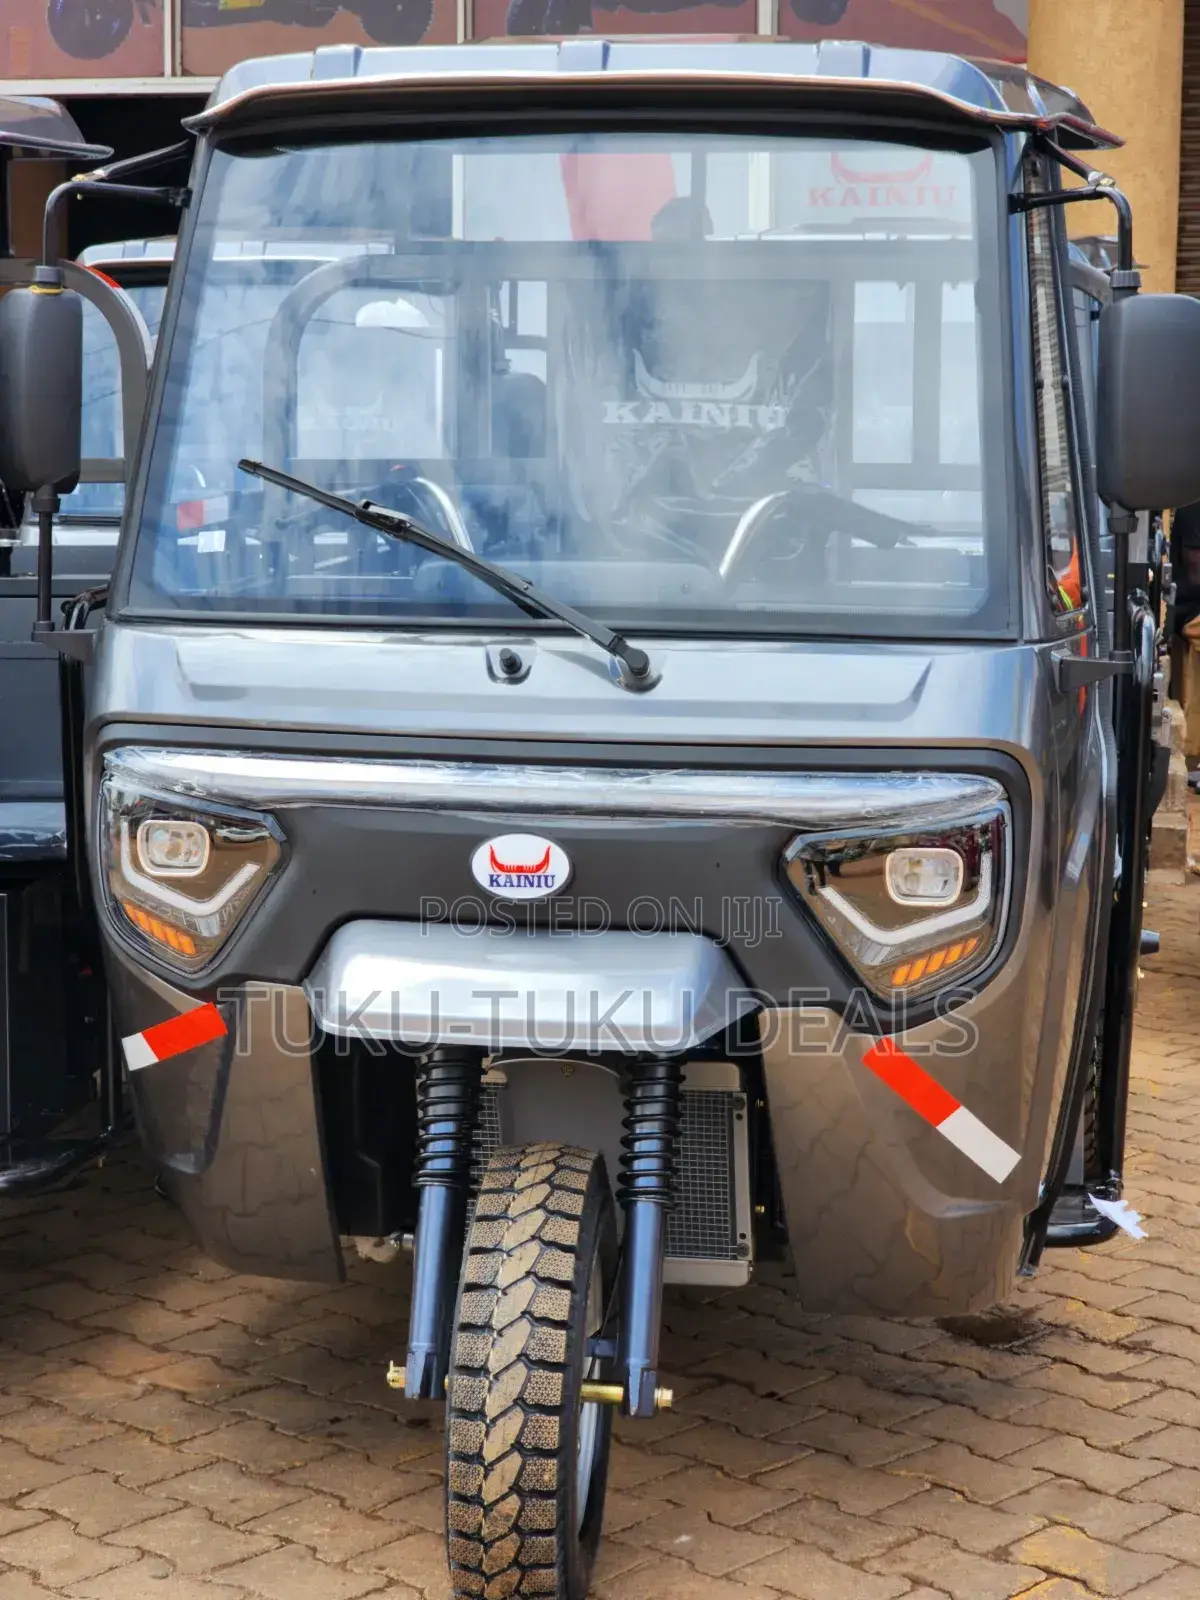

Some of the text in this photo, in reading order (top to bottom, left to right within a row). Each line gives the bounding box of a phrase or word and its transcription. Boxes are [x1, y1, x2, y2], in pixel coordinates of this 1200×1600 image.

[807, 186, 956, 207] KAINIU
[602, 401, 787, 430] KAINIU
[488, 874, 555, 888] KAINIU
